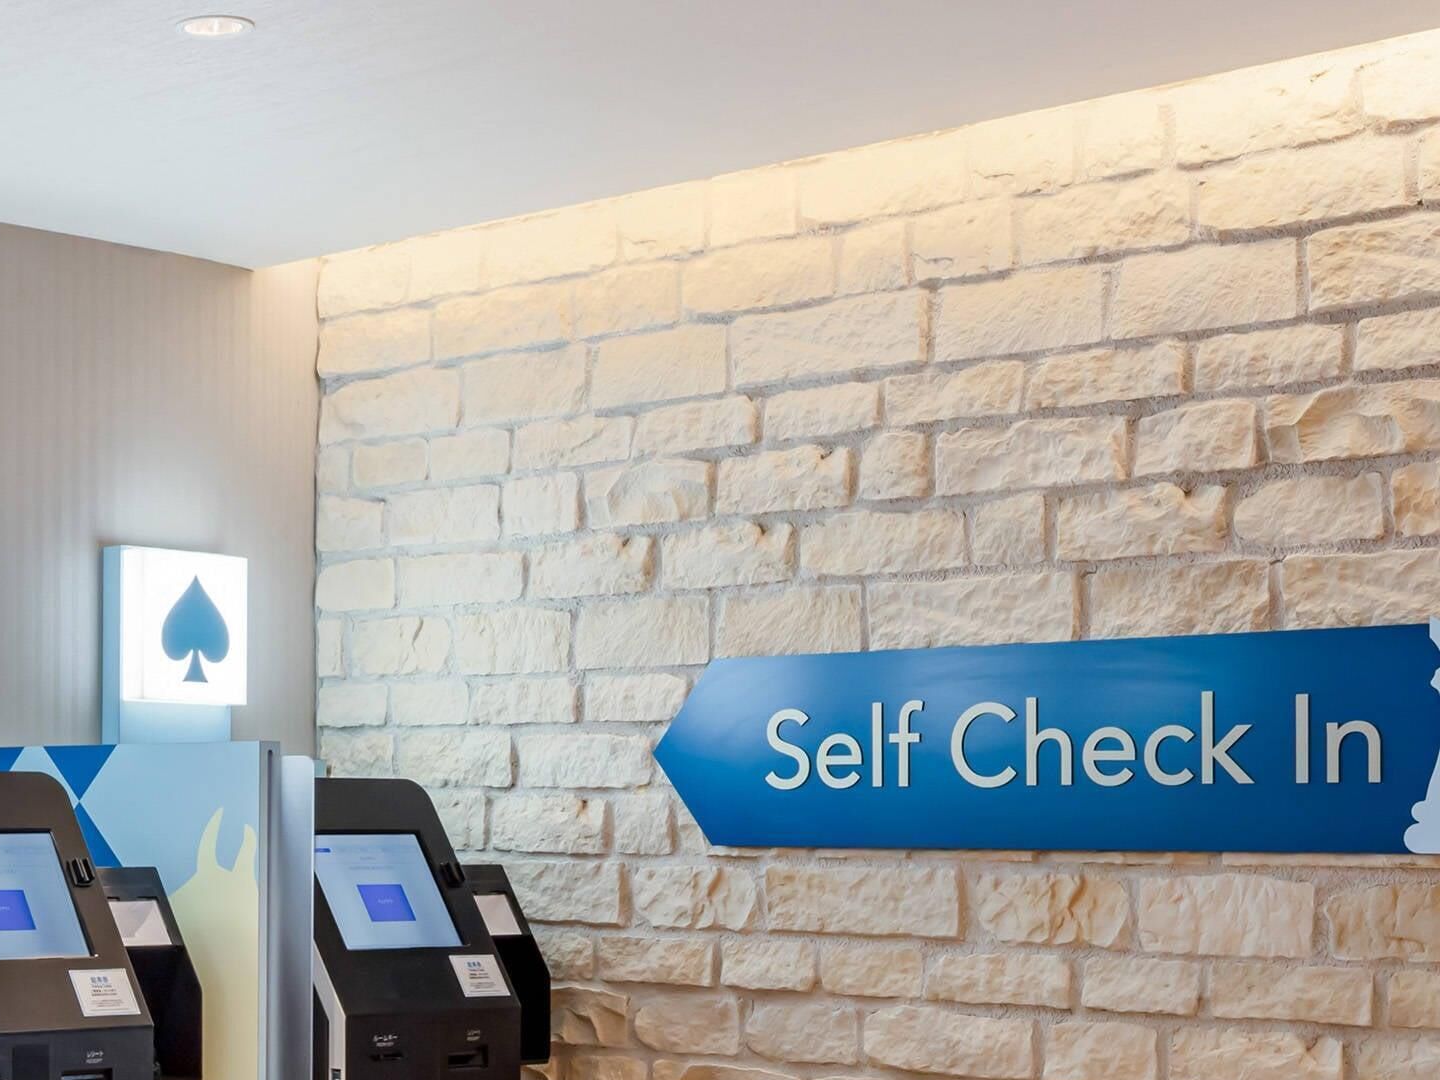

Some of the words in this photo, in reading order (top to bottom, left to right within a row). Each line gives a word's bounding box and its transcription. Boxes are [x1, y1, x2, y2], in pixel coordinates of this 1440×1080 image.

[764, 699, 924, 791] Self
[950, 690, 1255, 788] Check
[1295, 693, 1381, 784] In
